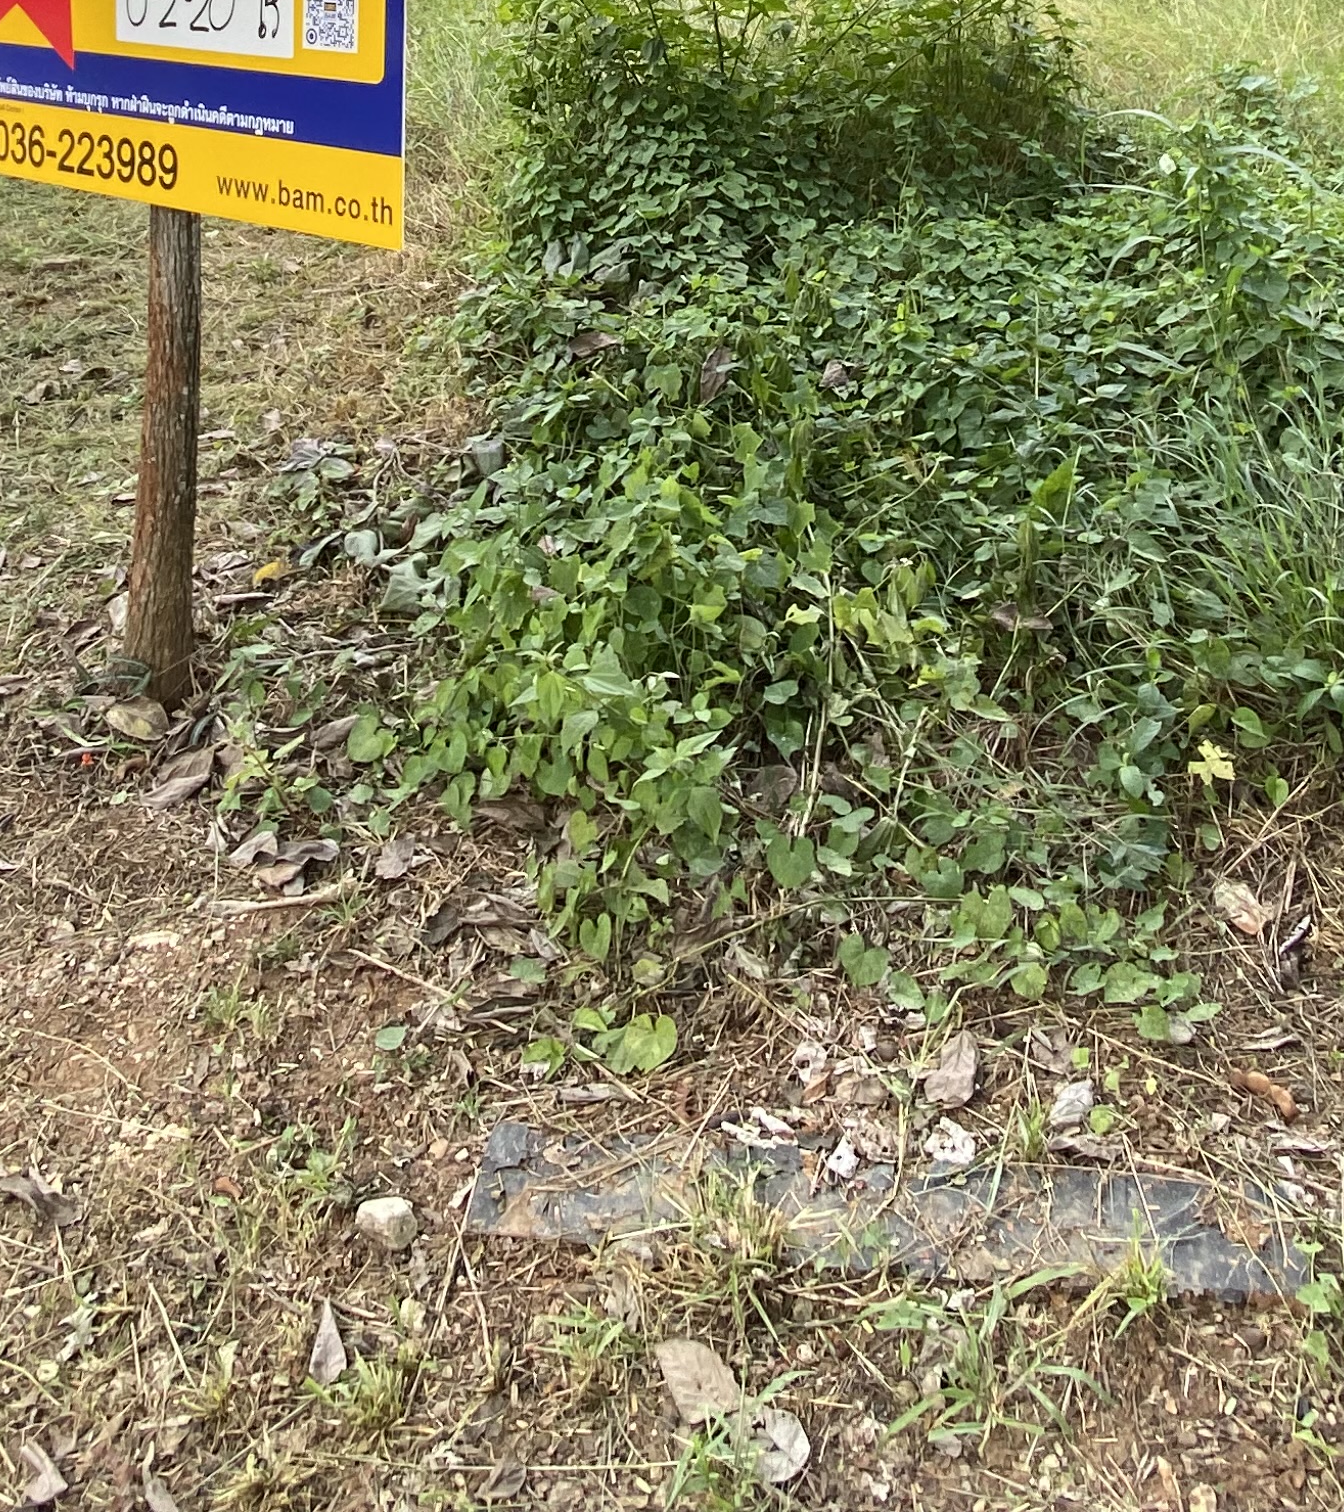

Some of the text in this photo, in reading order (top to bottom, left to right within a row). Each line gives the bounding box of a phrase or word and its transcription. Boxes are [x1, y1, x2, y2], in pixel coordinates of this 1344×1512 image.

[65, 84, 110, 114] ห้ามบุกรุก
[216, 175, 394, 226] www.bam.co.th
